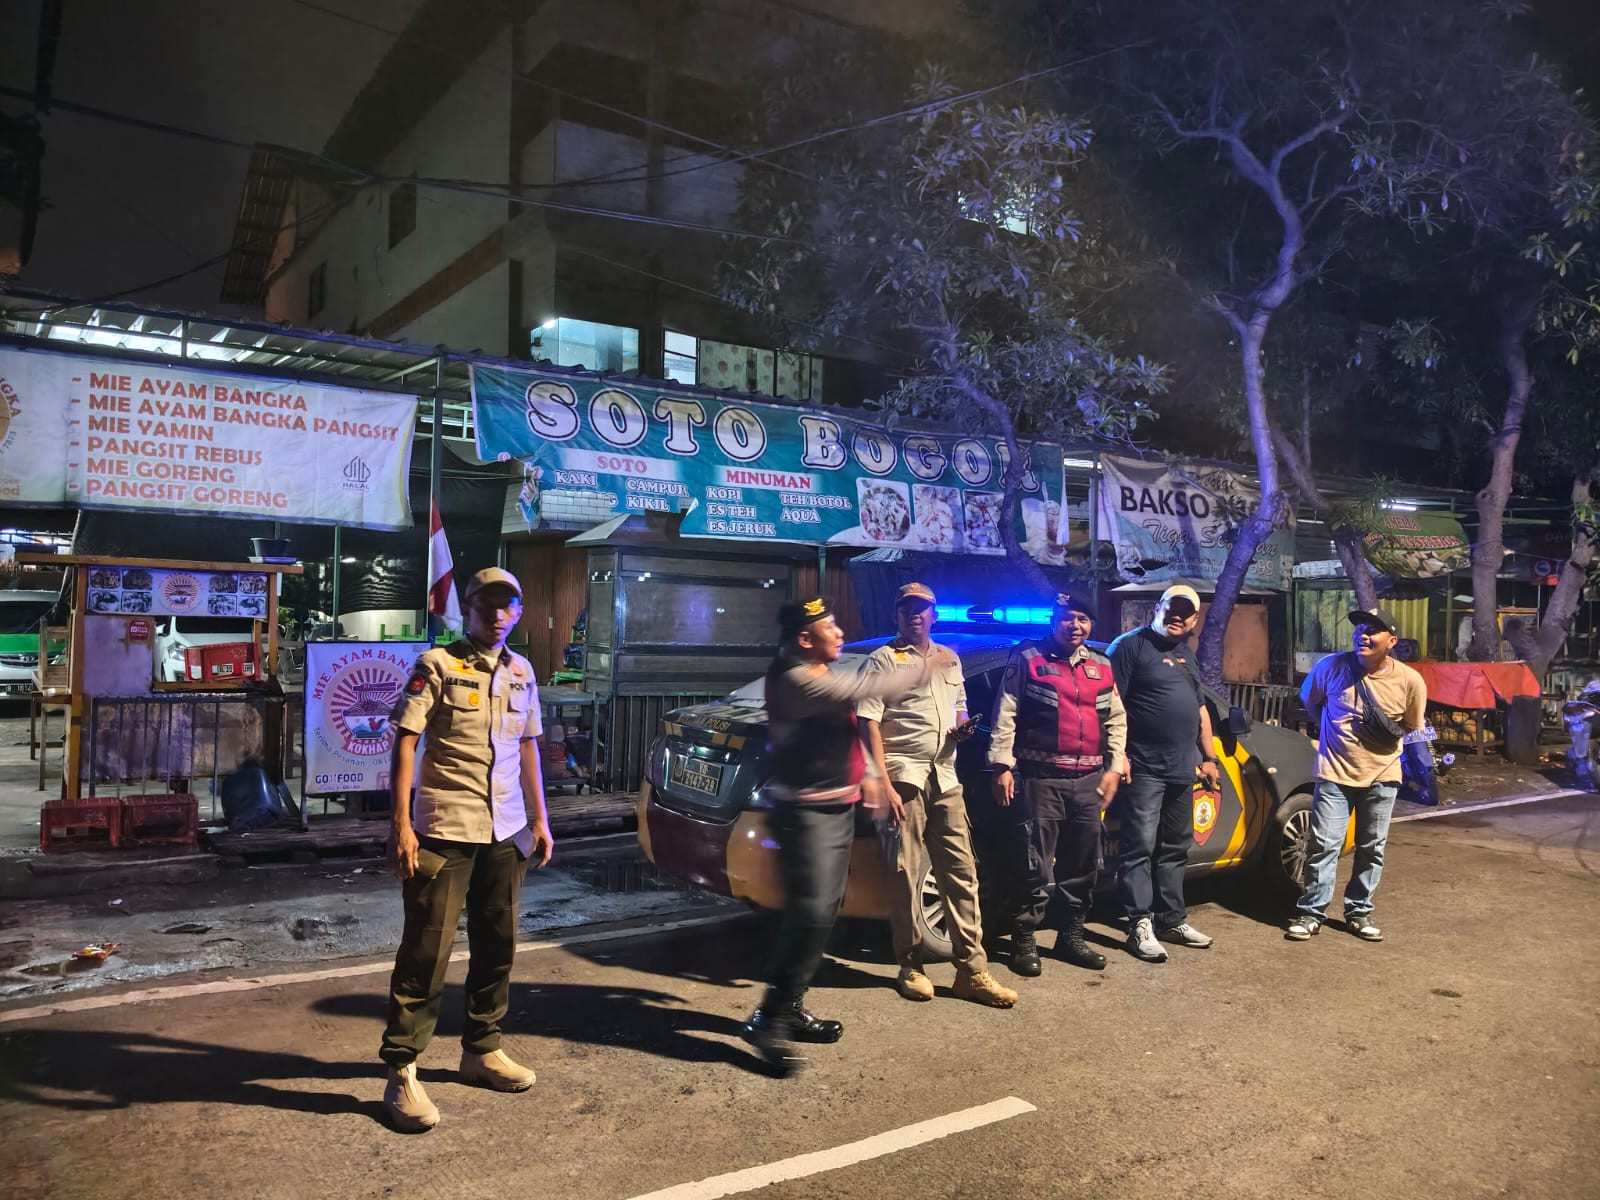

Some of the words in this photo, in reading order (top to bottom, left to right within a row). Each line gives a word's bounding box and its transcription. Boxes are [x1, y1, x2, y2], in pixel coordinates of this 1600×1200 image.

[90, 372, 132, 392] MIE
[138, 378, 207, 400] AYAM
[214, 384, 308, 411] BANGKA
[88, 394, 131, 413] MIE
[138, 399, 206, 420] AYAM
[213, 406, 307, 431] BANGKA
[313, 418, 399, 442] PANGSIT
[526, 380, 767, 462] SOTO
[88, 415, 131, 434] MIE
[137, 419, 214, 442] YAMIN
[87, 436, 189, 460] PANGSIT
[194, 445, 263, 466] REBUS
[87, 457, 129, 476] MIE
[136, 461, 236, 484] GORENG
[597, 455, 648, 474] SOTO
[555, 470, 598, 486] KAKI
[726, 469, 812, 489] MINUMAN
[86, 479, 187, 501] PANGSIT
[193, 486, 289, 509] GORENG
[626, 495, 670, 512] KIKIL
[706, 486, 742, 501] KOPI
[779, 492, 807, 506] TEH
[808, 494, 852, 509] BOTOL
[1119, 485, 1210, 518] BAKSO
[707, 504, 726, 517] ES
[727, 505, 756, 518] TEH
[780, 508, 821, 523] AQUA
[707, 520, 726, 533] ES
[727, 521, 776, 536] JERUK
[313, 671, 332, 700] MIE
[331, 648, 374, 674] AYAM
[315, 775, 329, 784] GO
[337, 773, 364, 783] FOOD
